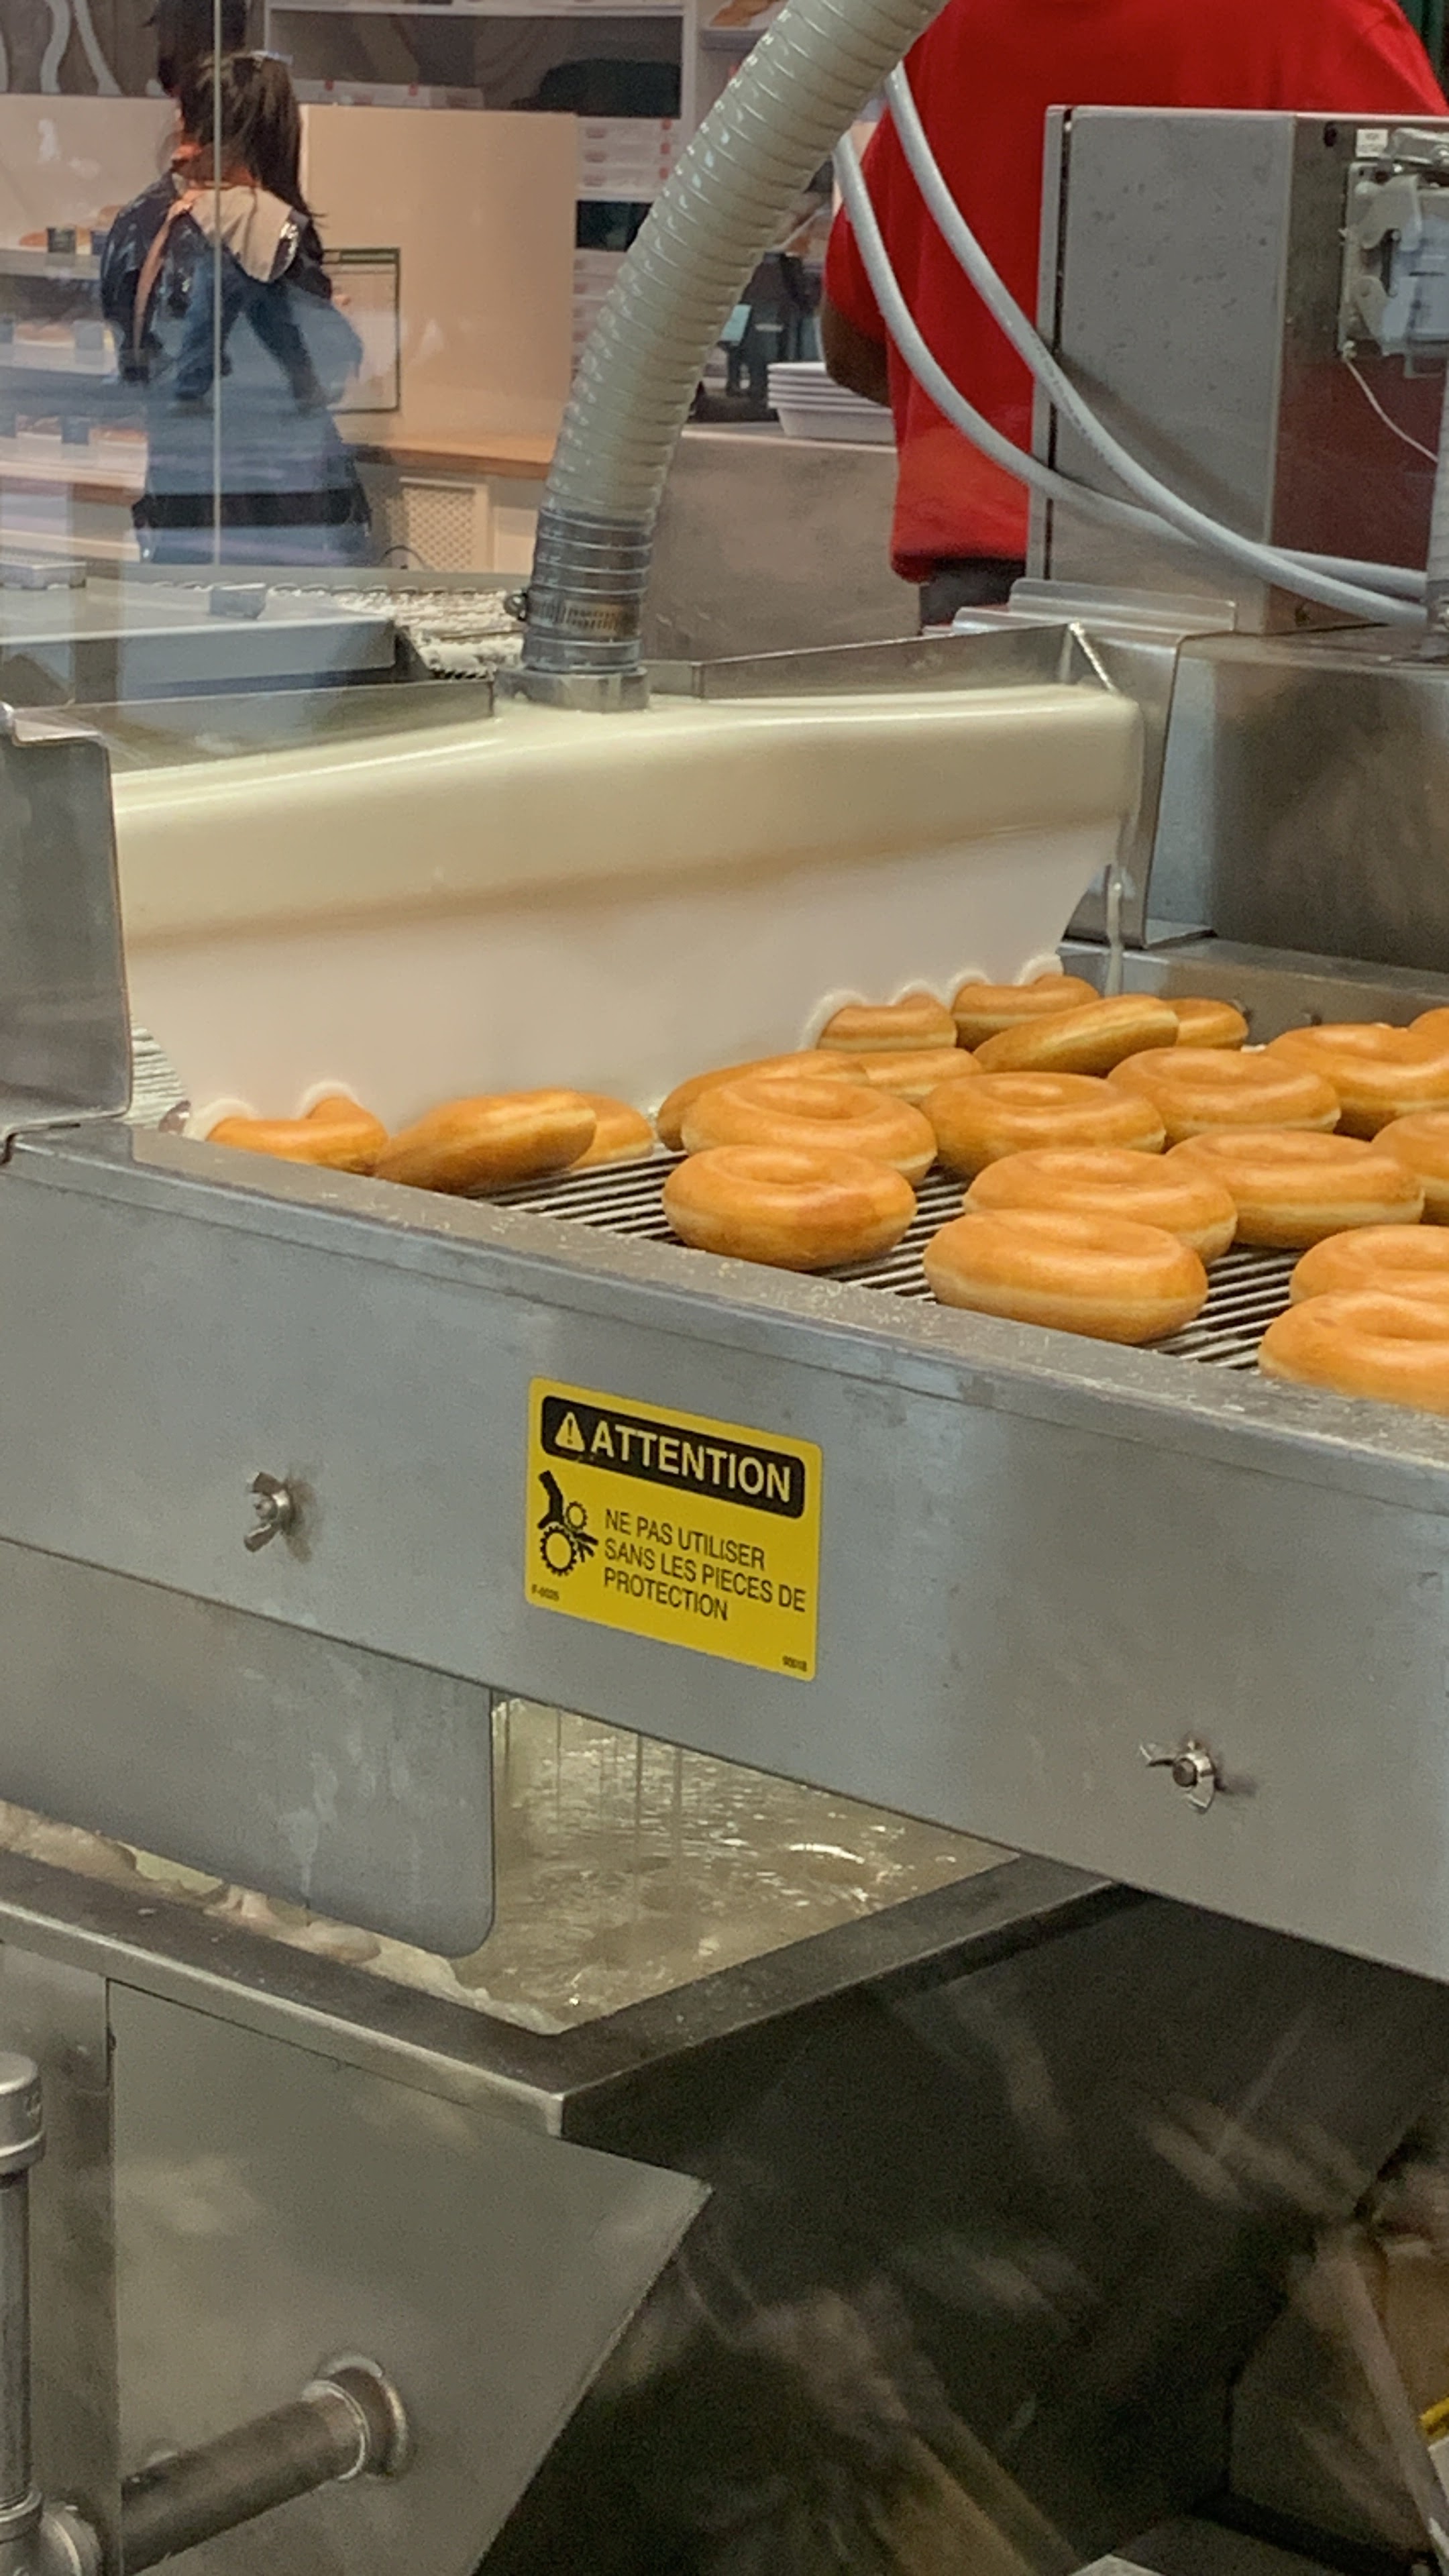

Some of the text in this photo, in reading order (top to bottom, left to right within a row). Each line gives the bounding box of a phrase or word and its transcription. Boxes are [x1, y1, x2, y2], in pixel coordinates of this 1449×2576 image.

[591, 1419, 790, 1503] ATTENTION
[605, 1509, 765, 1571] NE PAS UTILISER
[604, 1537, 806, 1613] SANS LES PIECES DE
[604, 1566, 728, 1621] PROTECTION
